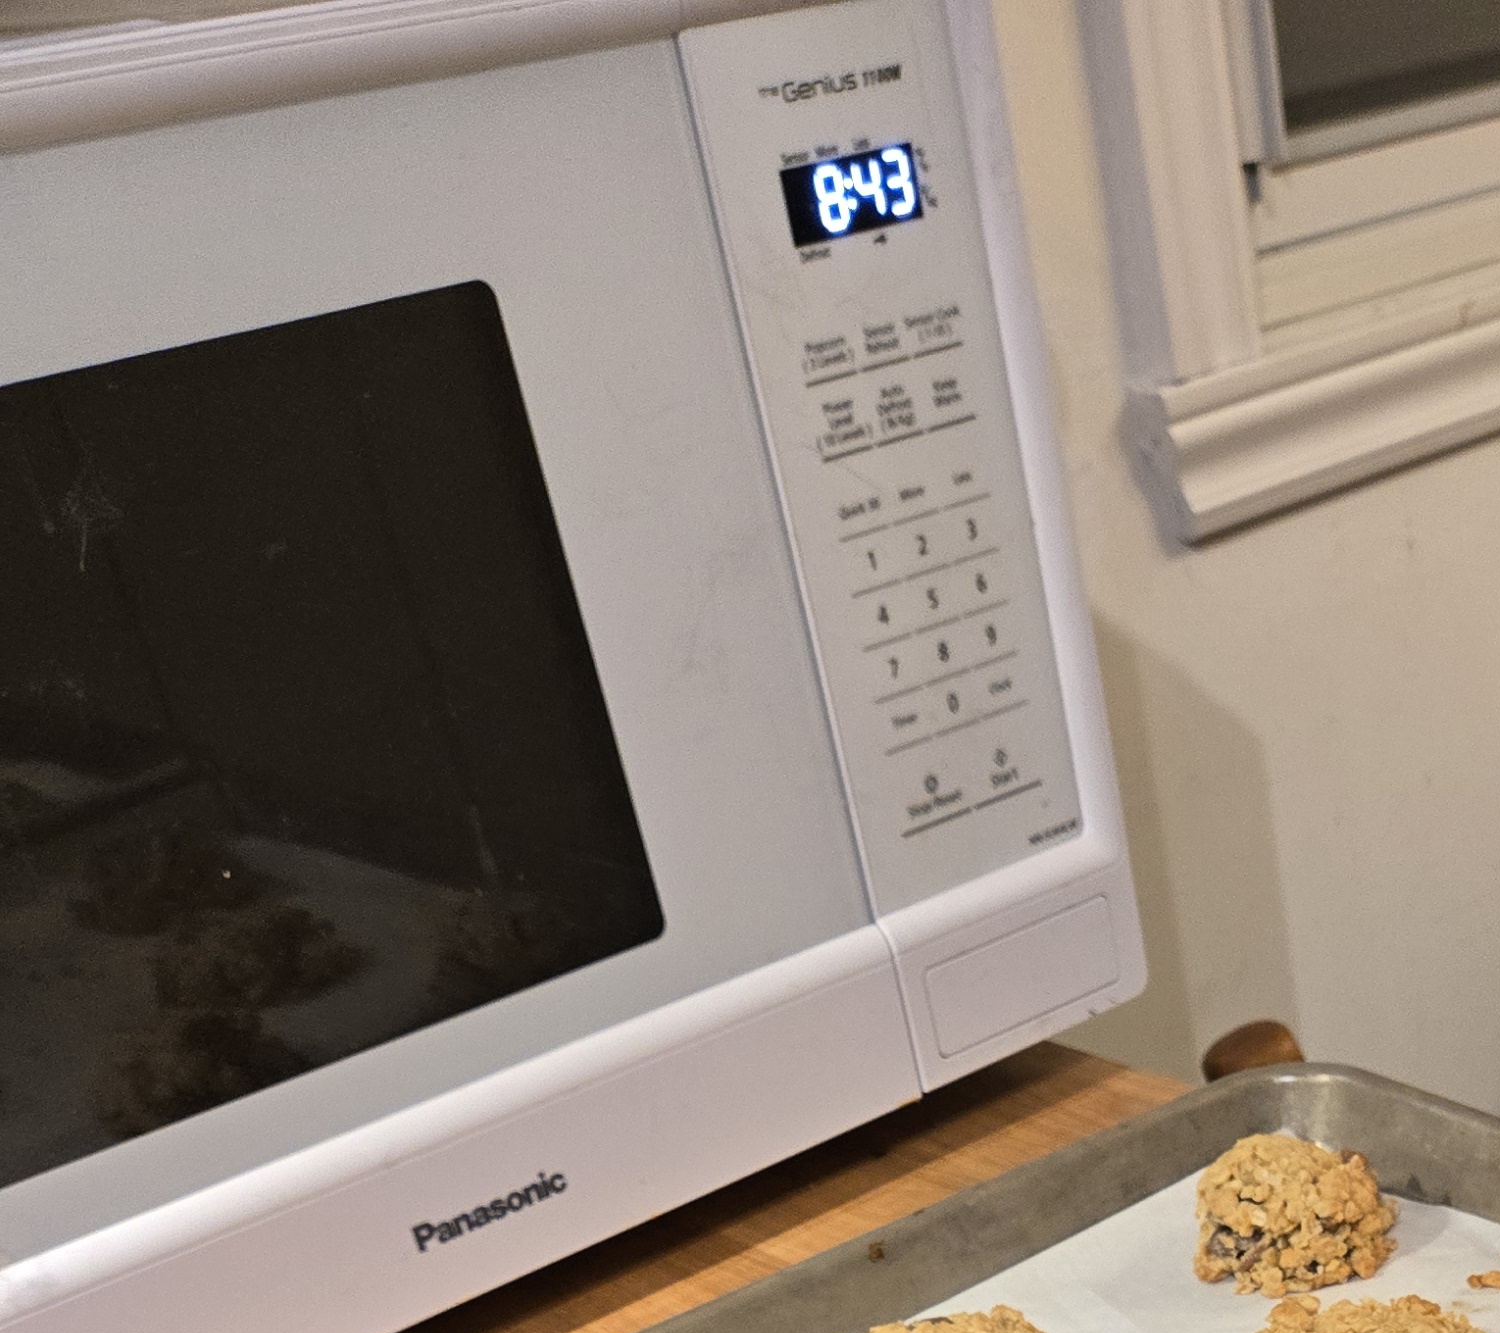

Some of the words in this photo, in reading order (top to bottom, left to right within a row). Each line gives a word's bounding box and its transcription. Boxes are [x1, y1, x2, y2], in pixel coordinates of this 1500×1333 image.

[781, 72, 857, 103] Genius
[813, 148, 915, 233] 8:43
[867, 549, 878, 571] 1
[916, 533, 928, 556] 2
[965, 517, 979, 541] 3
[878, 603, 890, 625] 4
[926, 587, 940, 610] 5
[975, 571, 988, 595] 6
[888, 656, 899, 680] 7
[937, 640, 950, 663] 8
[985, 624, 998, 647] 9
[946, 689, 960, 714] 0
[411, 1170, 568, 1253] Panasonic
